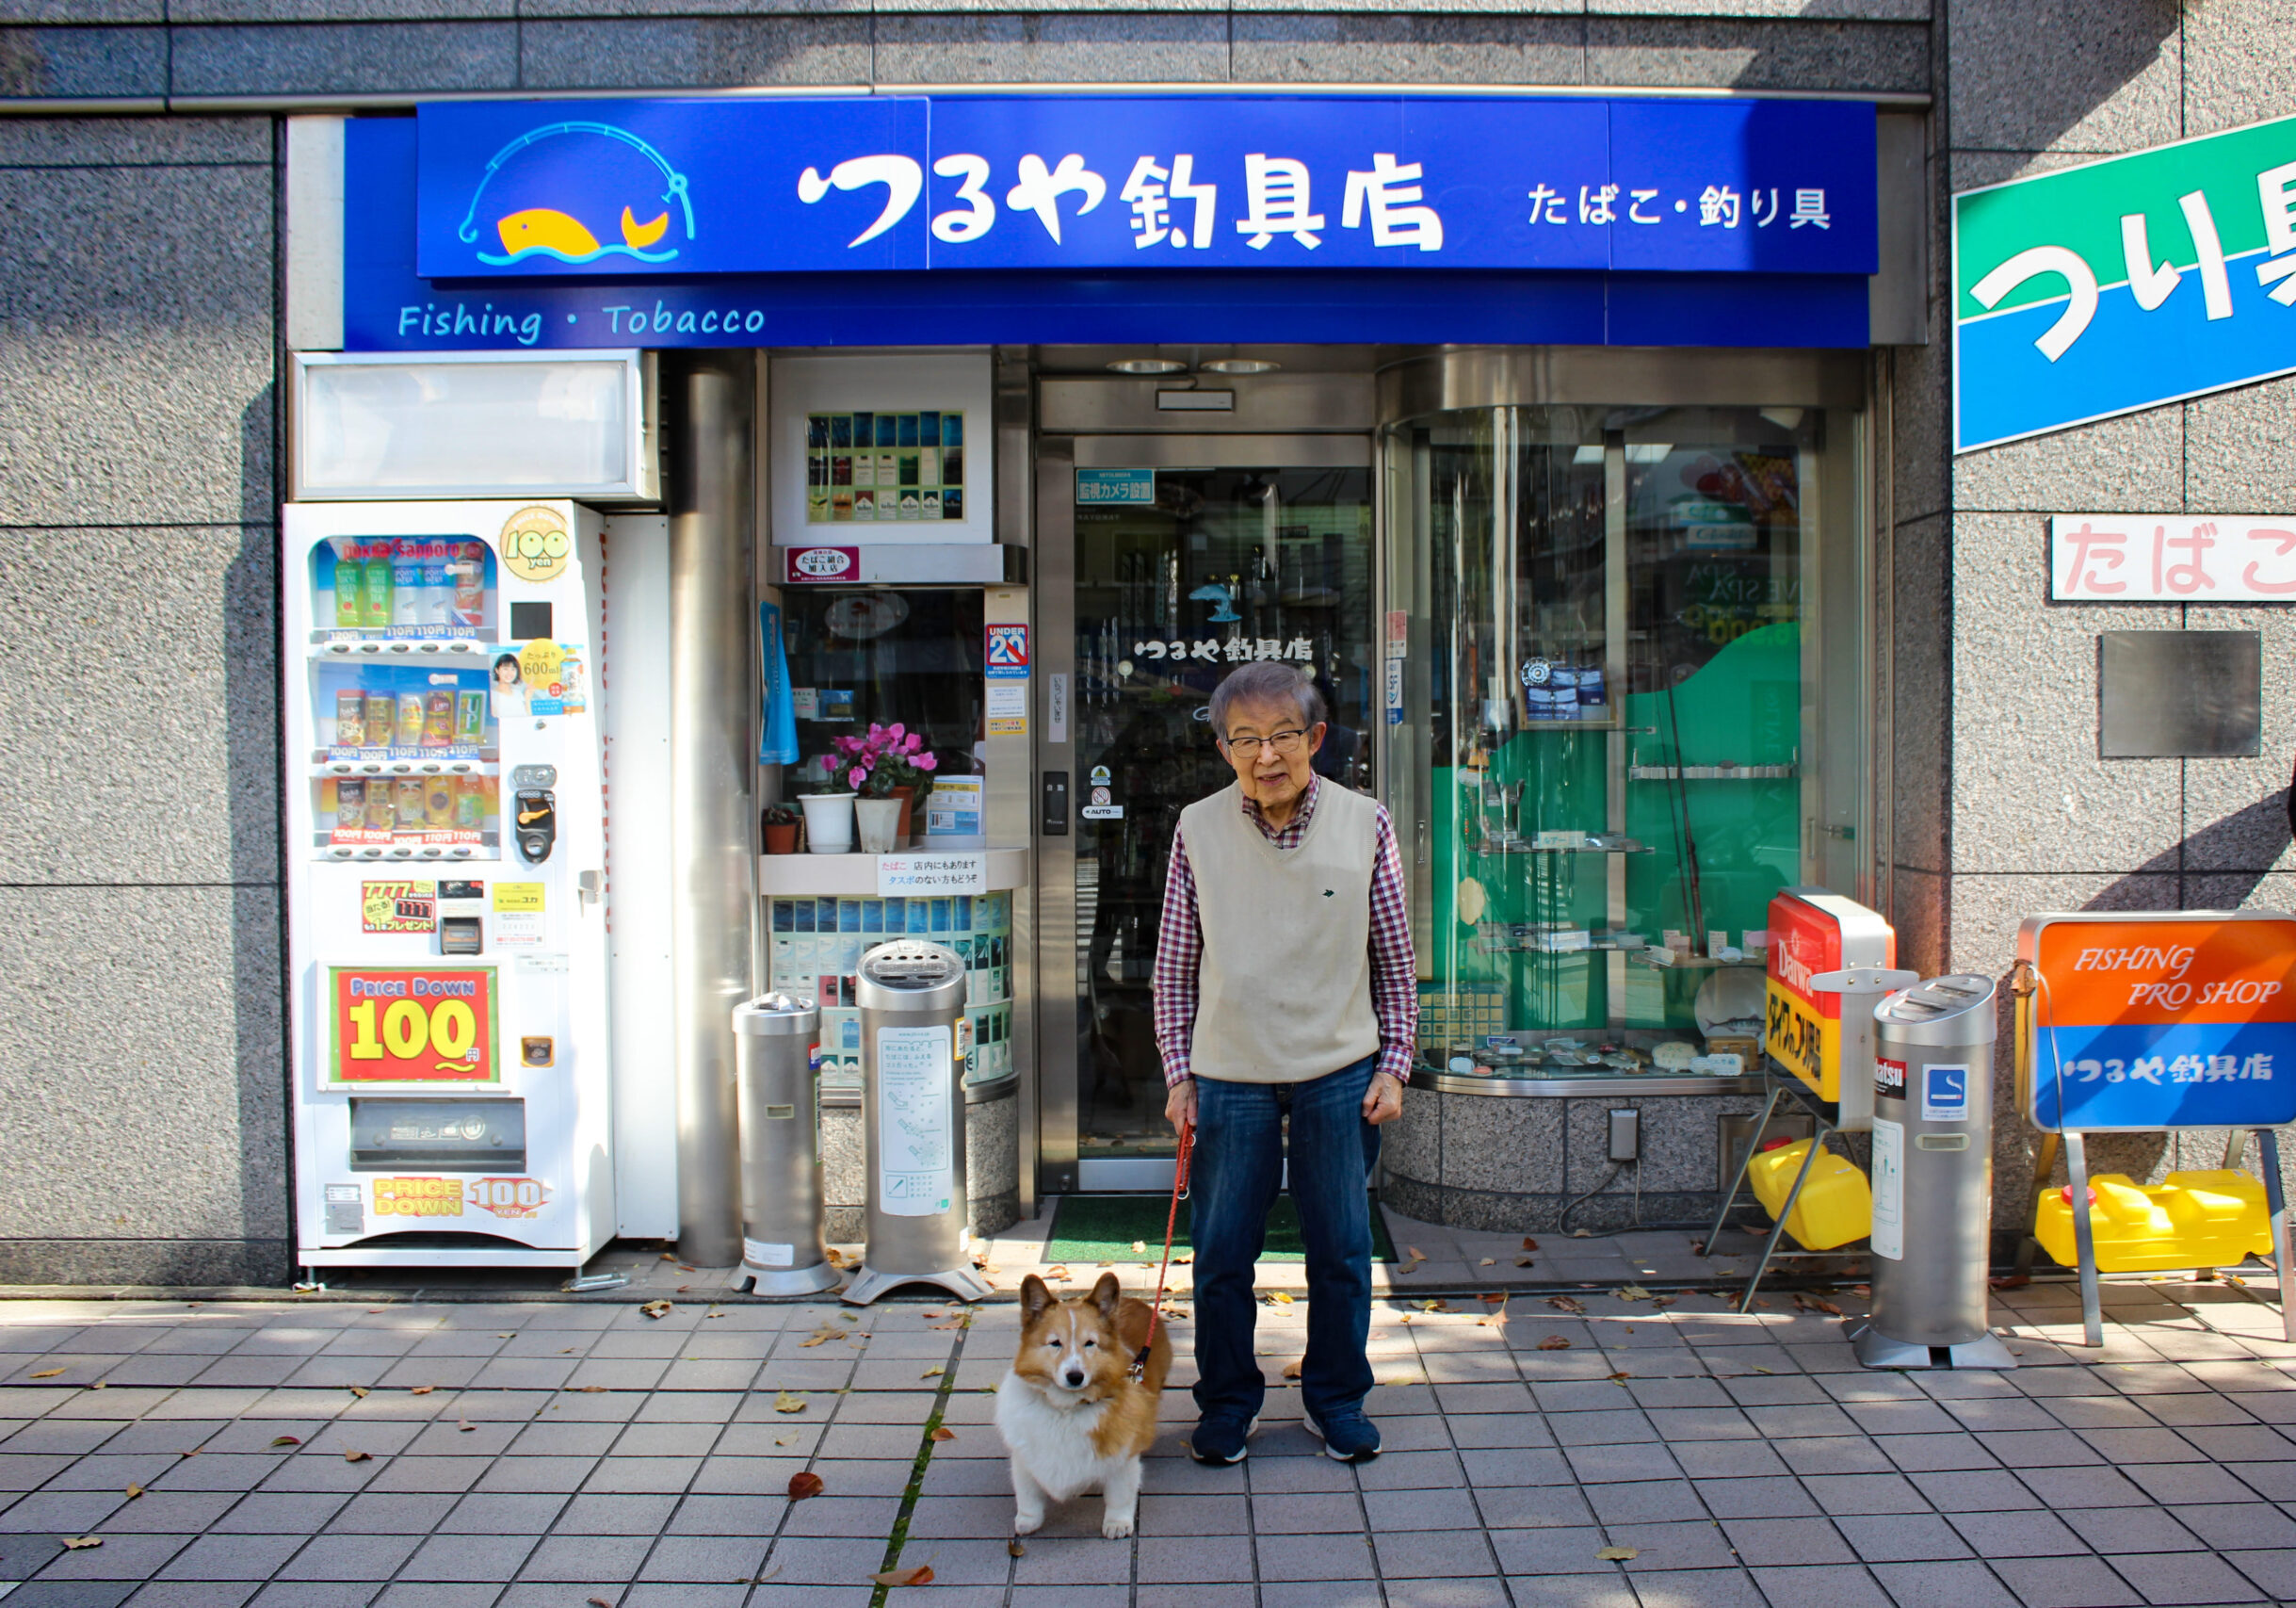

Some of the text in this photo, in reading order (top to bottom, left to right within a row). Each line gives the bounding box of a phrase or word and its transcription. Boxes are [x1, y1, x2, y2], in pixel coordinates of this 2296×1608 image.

[797, 154, 1443, 252] つるや釣具店
[1528, 182, 1831, 230] たばこ・釣り具
[397, 300, 764, 345] Fishing Tobacco
[506, 530, 570, 559] 100
[2064, 522, 2296, 594] たばこ
[528, 558, 553, 570] yen
[989, 635, 1025, 663] 20
[1134, 637, 1313, 662] つるや釣具店
[881, 860, 977, 871] たばこ 店内にもあります
[889, 874, 978, 885] タスポのない方もどうぞ
[363, 882, 412, 899] 7777
[1778, 939, 1813, 998] Daiwa
[2075, 945, 2195, 980] FISHING
[351, 978, 476, 996] PRICE DOWN
[2127, 980, 2282, 1011] PRO SHOP
[2062, 1053, 2274, 1085] つるや釣具店
[373, 1178, 463, 1197] PRICE
[470, 1179, 542, 1208] 100
[373, 1197, 463, 1216] DOWN
[495, 1208, 520, 1216] YEN
